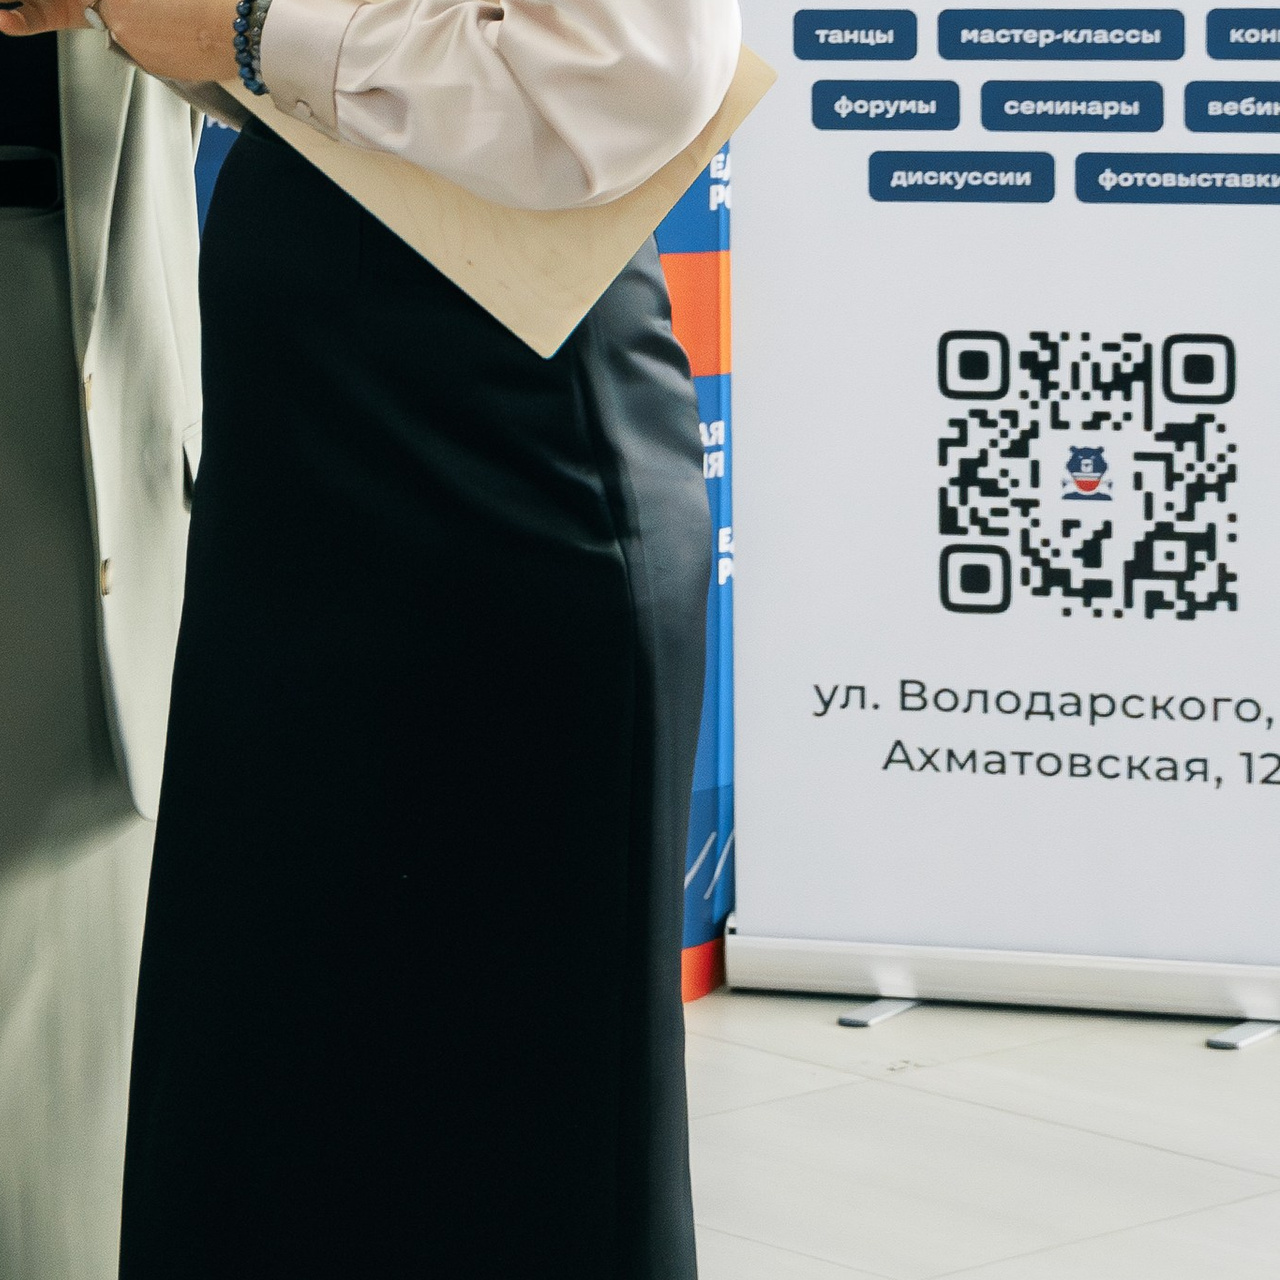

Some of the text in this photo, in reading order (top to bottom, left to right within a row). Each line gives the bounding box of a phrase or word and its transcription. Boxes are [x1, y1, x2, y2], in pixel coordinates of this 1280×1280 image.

[815, 29, 894, 46] танцы
[960, 28, 1162, 48] мастер-классы
[1229, 28, 1280, 44] кон
[834, 94, 937, 119] форумы
[1004, 99, 1140, 120] семинары
[890, 170, 1032, 190] дискуссии
[814, 678, 1274, 730] ул. Володарского,
[882, 738, 1280, 790] Ахматовская, 12
